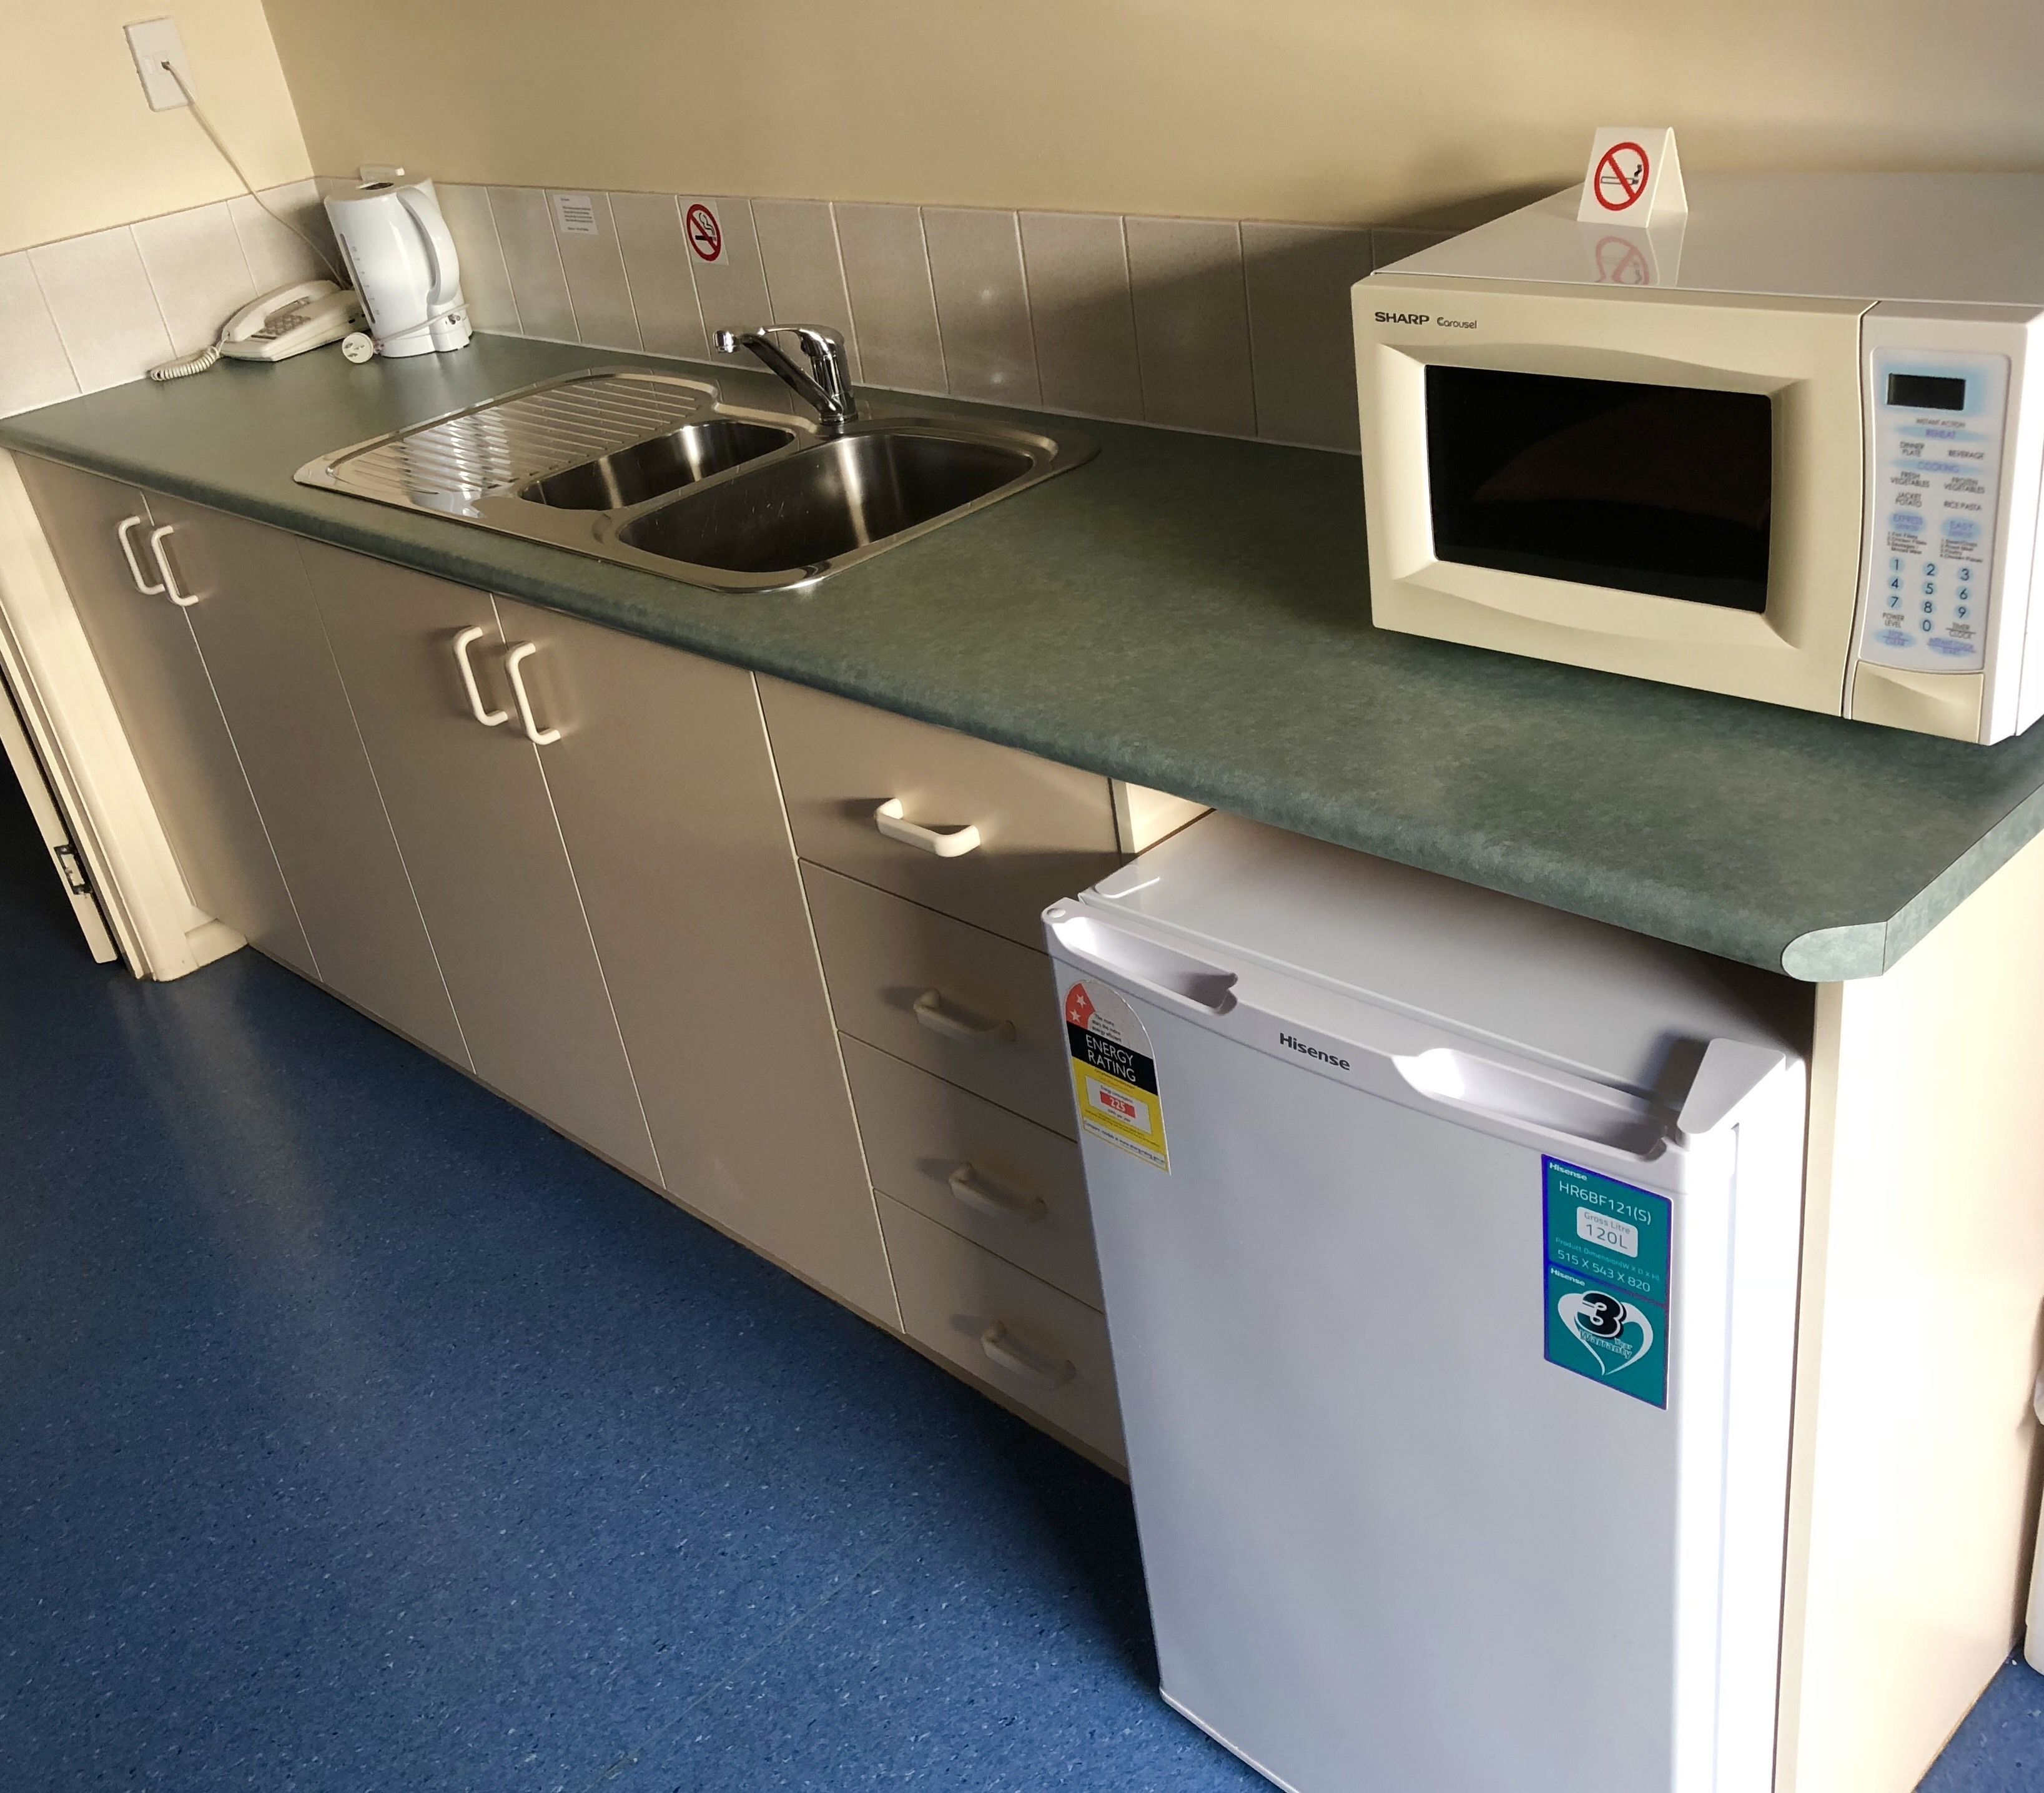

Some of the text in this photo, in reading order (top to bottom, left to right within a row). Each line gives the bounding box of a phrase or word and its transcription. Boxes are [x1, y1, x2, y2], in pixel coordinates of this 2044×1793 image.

[1375, 312, 1478, 329] SHARP Carousel
[1948, 450, 1985, 460] BEVERAGE
[1900, 471, 1920, 479] FRESH
[1890, 477, 1930, 488] VEGETABLES
[1944, 483, 1985, 494] VEGETABLES
[1897, 492, 1921, 500] JACKET
[1895, 498, 1923, 508] POTATO
[1894, 559, 1899, 571] 1
[1927, 563, 1936, 576] 2
[1960, 568, 1970, 581] 3
[1891, 578, 1899, 589] 4
[1925, 583, 1934, 595] 5
[1959, 588, 1968, 600] 6
[1891, 596, 1899, 608] 7
[1923, 601, 1933, 614] 8
[1882, 612, 1905, 621] POWER
[1958, 606, 1967, 619] 9
[1884, 620, 1902, 629] LEVEL
[1922, 619, 1932, 632] 0
[1948, 630, 1972, 639] CLOCK
[1086, 1034, 1133, 1066] ENERGY
[1280, 1032, 1350, 1070] Hisense
[1088, 1049, 1136, 1082] RATING
[1110, 1097, 1125, 1112] 225
[1549, 1162, 1587, 1181] Hisense
[1559, 1180, 1651, 1225] HR6BF121(S)
[1584, 1212, 1631, 1235] Gross Litre
[1586, 1224, 1629, 1250] 120L
[1556, 1237, 1582, 1253] Product
[1551, 1268, 1586, 1287] Hisense
[1558, 1250, 1579, 1265] 515
[1592, 1263, 1614, 1279] 543
[1627, 1277, 1651, 1292] 820
[1576, 1290, 1626, 1340] 3
[1579, 1328, 1632, 1360] Warranty
